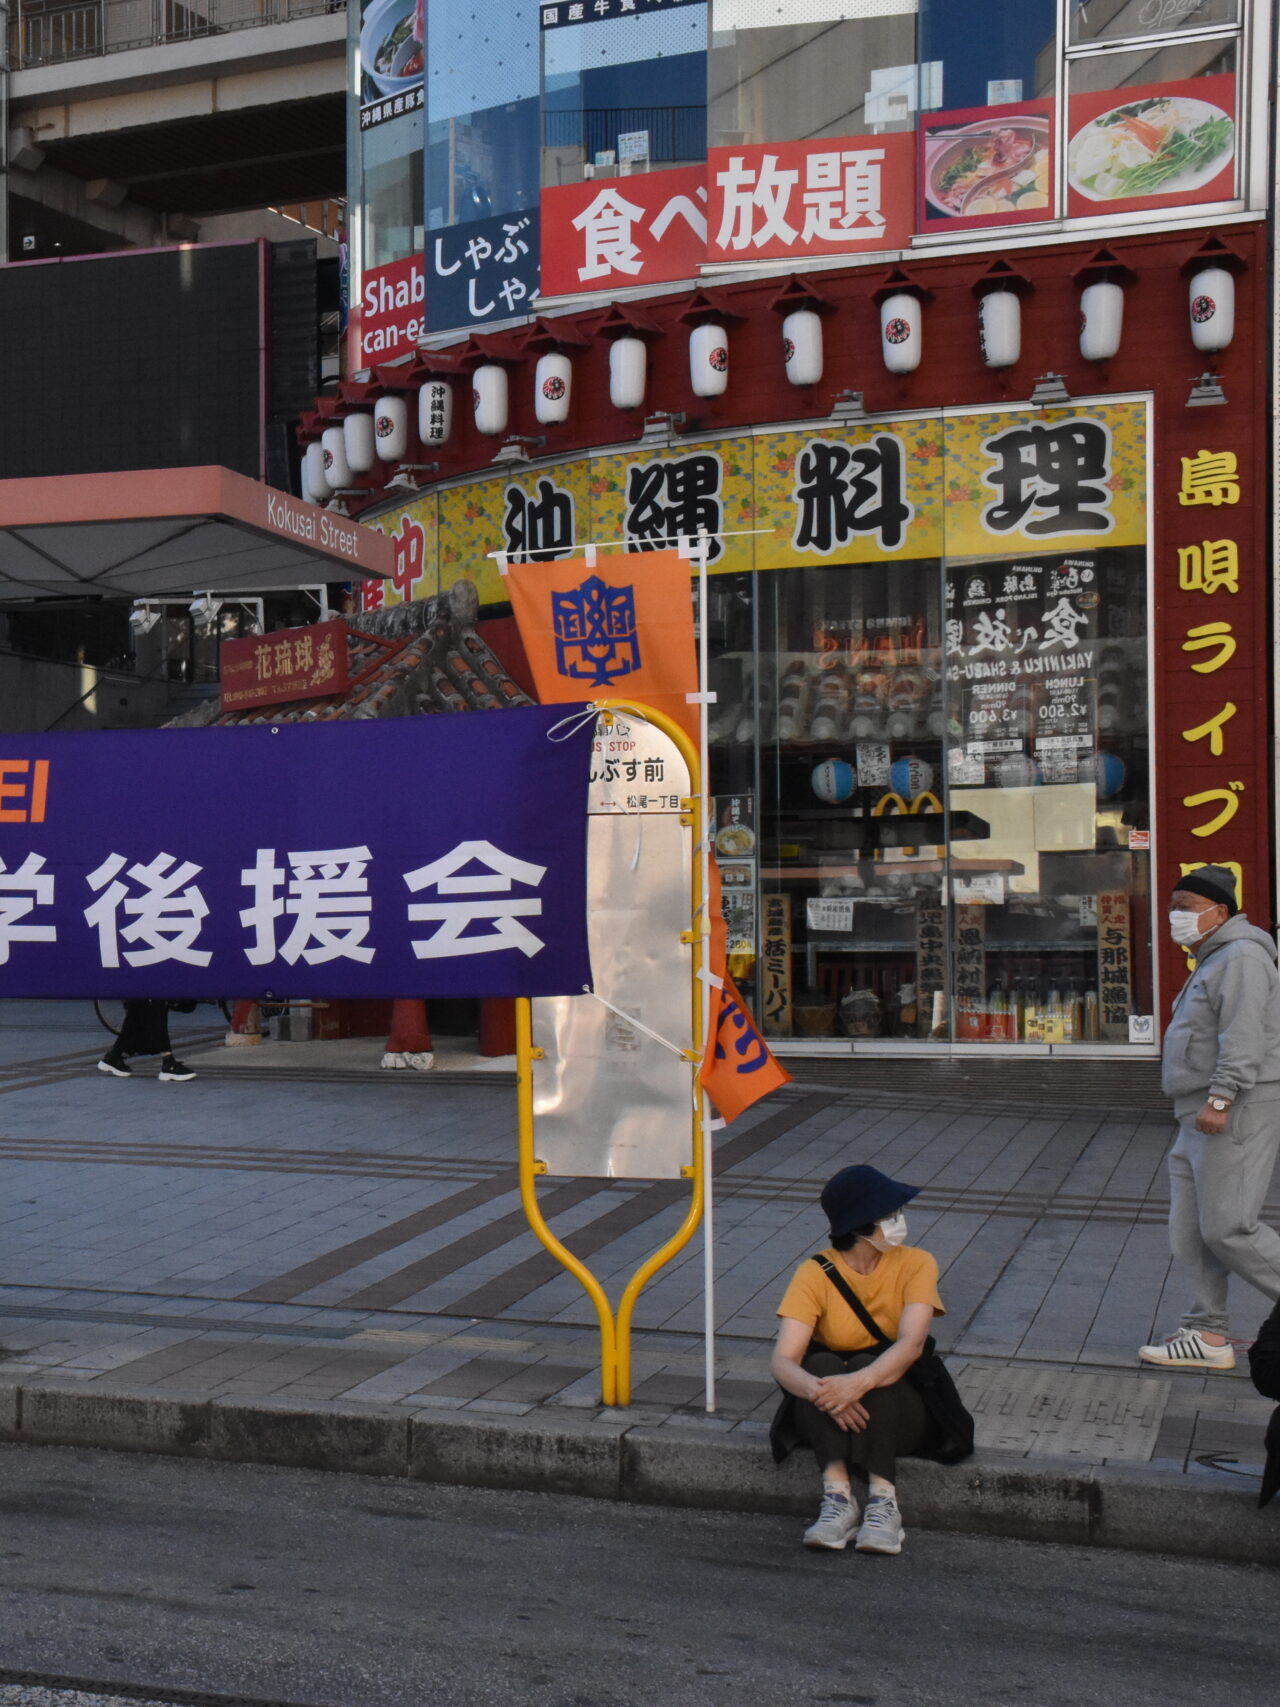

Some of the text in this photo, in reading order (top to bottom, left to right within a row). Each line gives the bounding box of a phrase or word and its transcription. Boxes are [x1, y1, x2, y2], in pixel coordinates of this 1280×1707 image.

[572, 148, 887, 282] 食べ放題
[435, 217, 531, 277] しゃぶ
[362, 266, 424, 318] Shab
[468, 265, 540, 317] しゃ
[429, 385, 446, 440] 沖縄料理
[505, 420, 1113, 563] 沖縄料理
[267, 494, 359, 558] Kokusai Street
[608, 741, 637, 752] STOP
[626, 794, 679, 809] 松尾一丁目
